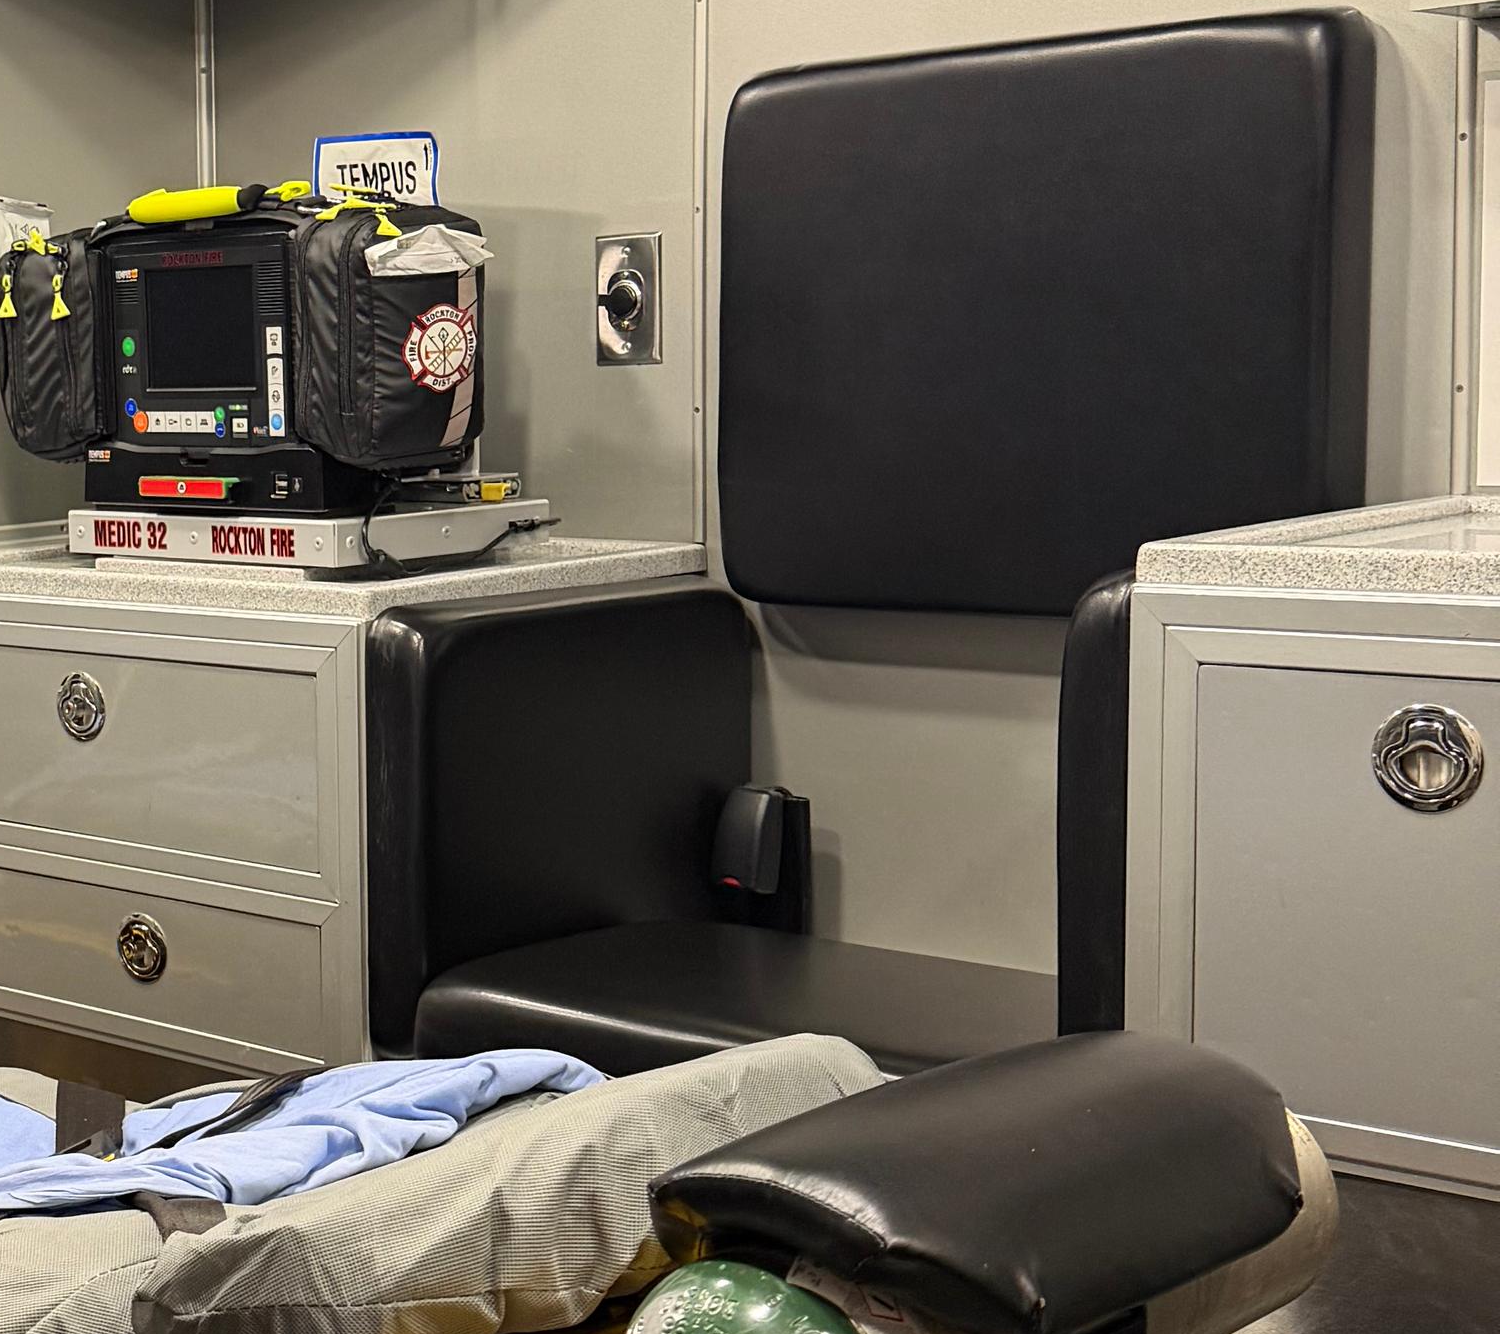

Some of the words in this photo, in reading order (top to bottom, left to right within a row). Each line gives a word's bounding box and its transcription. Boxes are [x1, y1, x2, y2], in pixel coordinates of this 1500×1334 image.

[336, 160, 417, 197] TEMPUS
[204, 251, 224, 264] FIRE
[425, 310, 460, 323] ROCKTON
[408, 340, 418, 363] FIRE
[94, 519, 142, 549] MEDIC
[147, 521, 168, 550] 32
[211, 525, 265, 556] ROCKTON
[270, 528, 296, 558] FIRE
